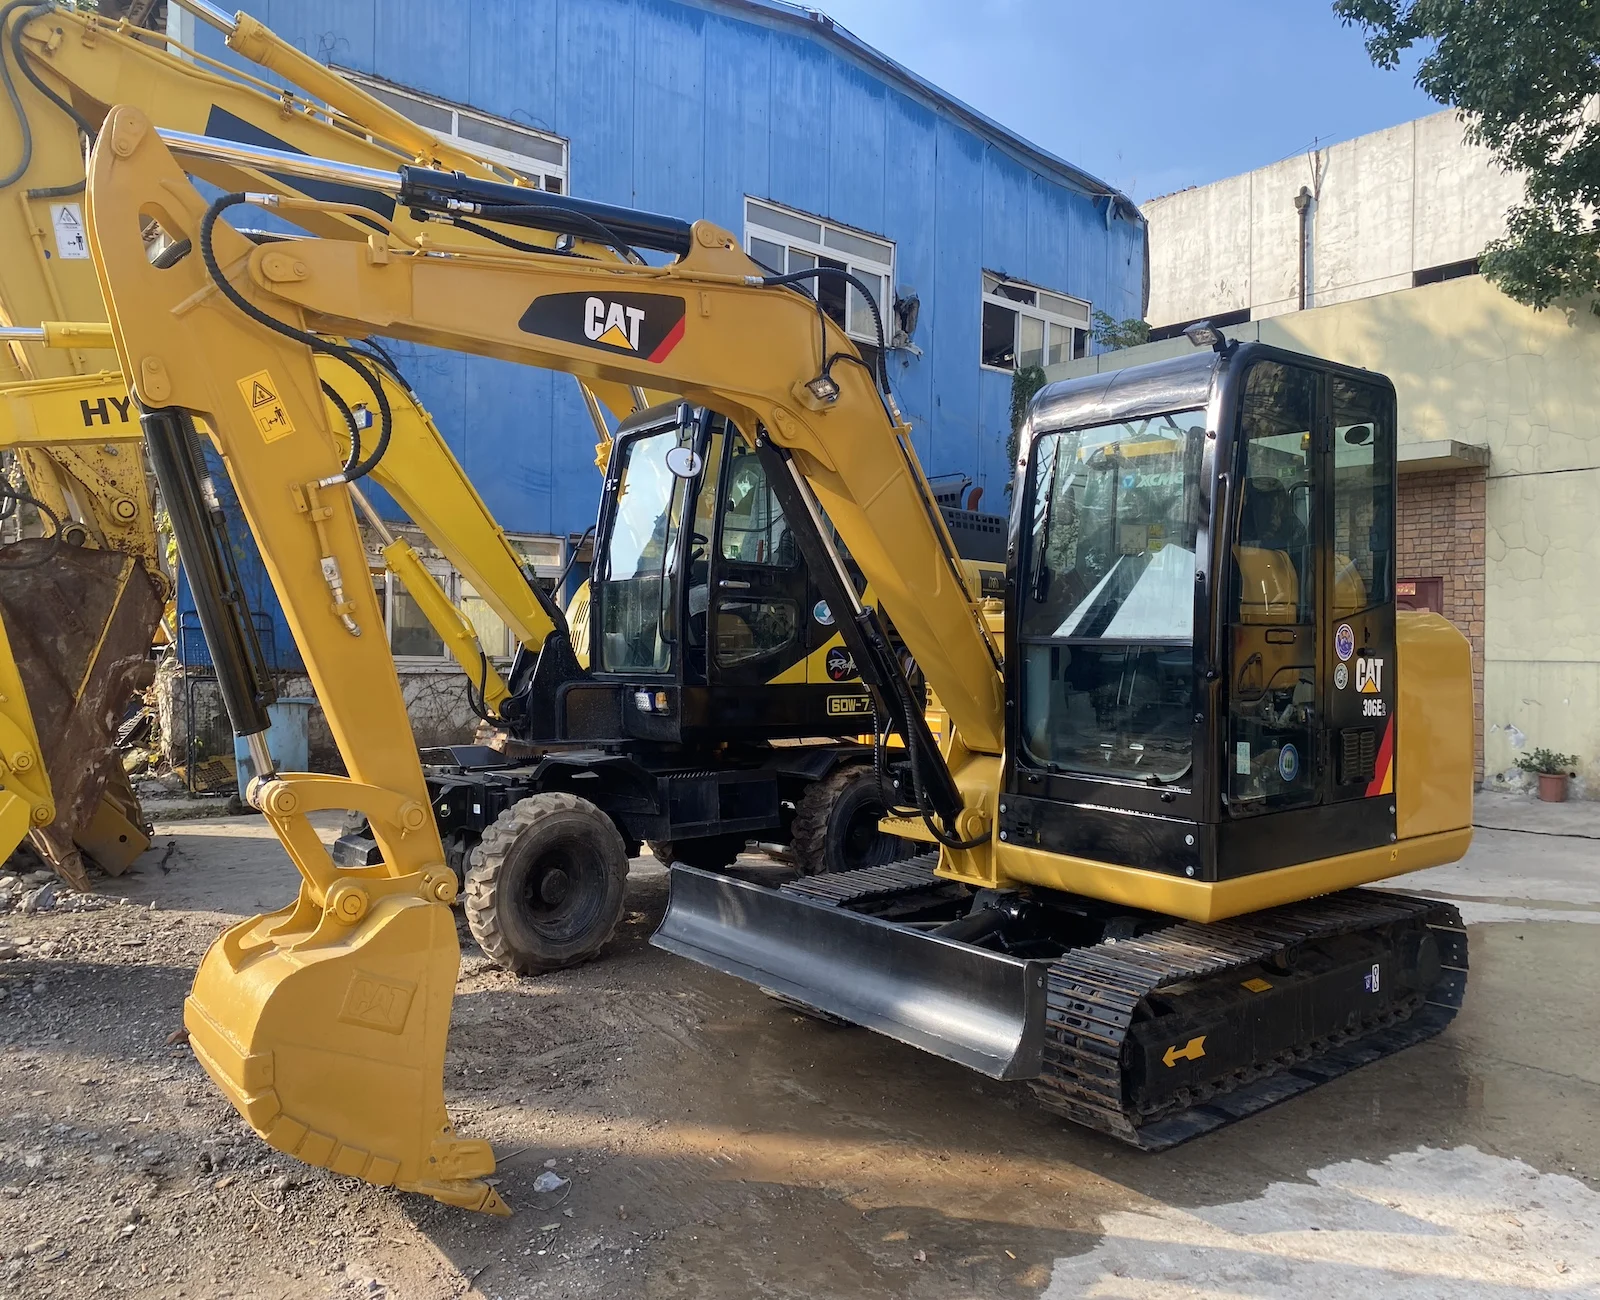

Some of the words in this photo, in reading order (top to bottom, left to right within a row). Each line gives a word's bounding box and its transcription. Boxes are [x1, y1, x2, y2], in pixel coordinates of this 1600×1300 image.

[583, 295, 645, 351] CAT
[80, 396, 131, 426] HY
[1355, 657, 1384, 693] CAT
[348, 979, 410, 1026] CAT
